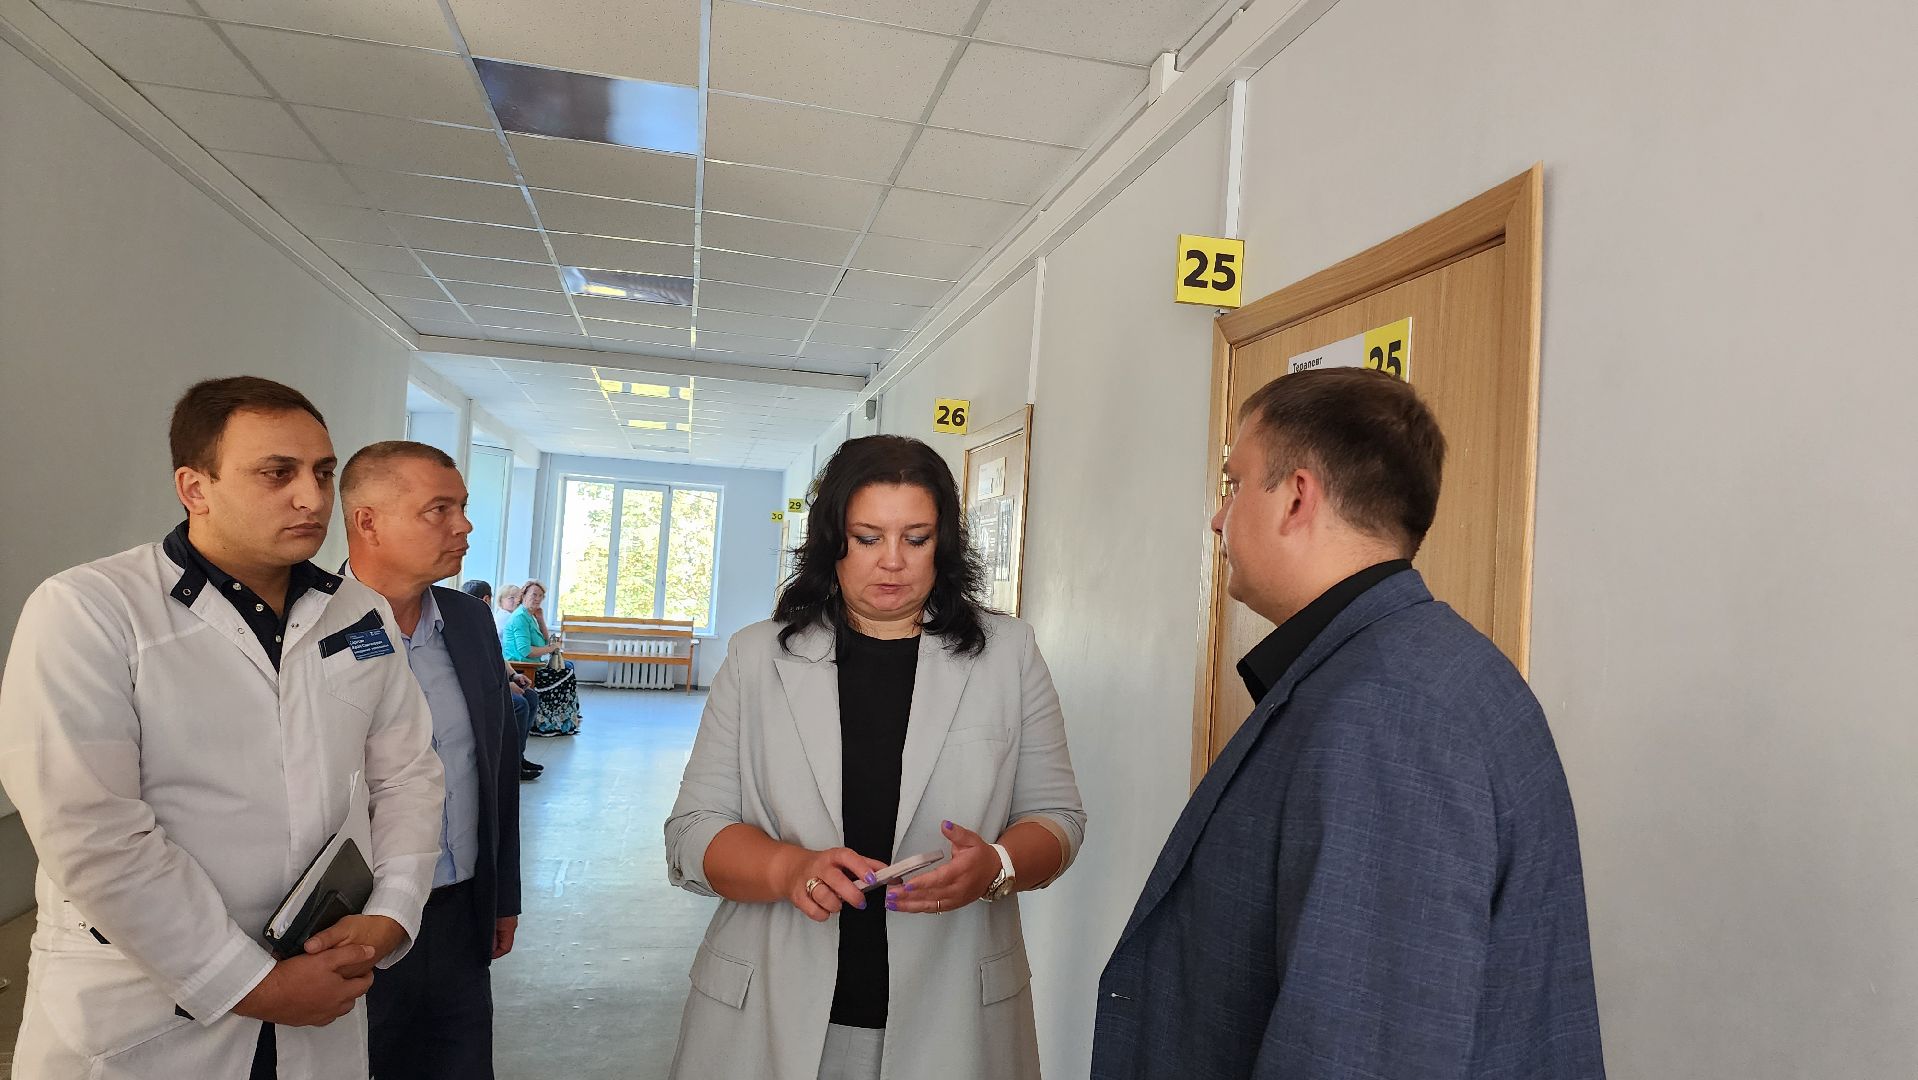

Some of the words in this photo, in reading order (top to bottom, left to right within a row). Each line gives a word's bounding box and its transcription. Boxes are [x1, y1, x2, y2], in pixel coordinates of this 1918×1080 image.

[1183, 249, 1236, 291] 25
[1292, 356, 1323, 374] Терапевт
[936, 405, 966, 426] 26
[789, 501, 802, 510] 29
[771, 512, 783, 520] 30
